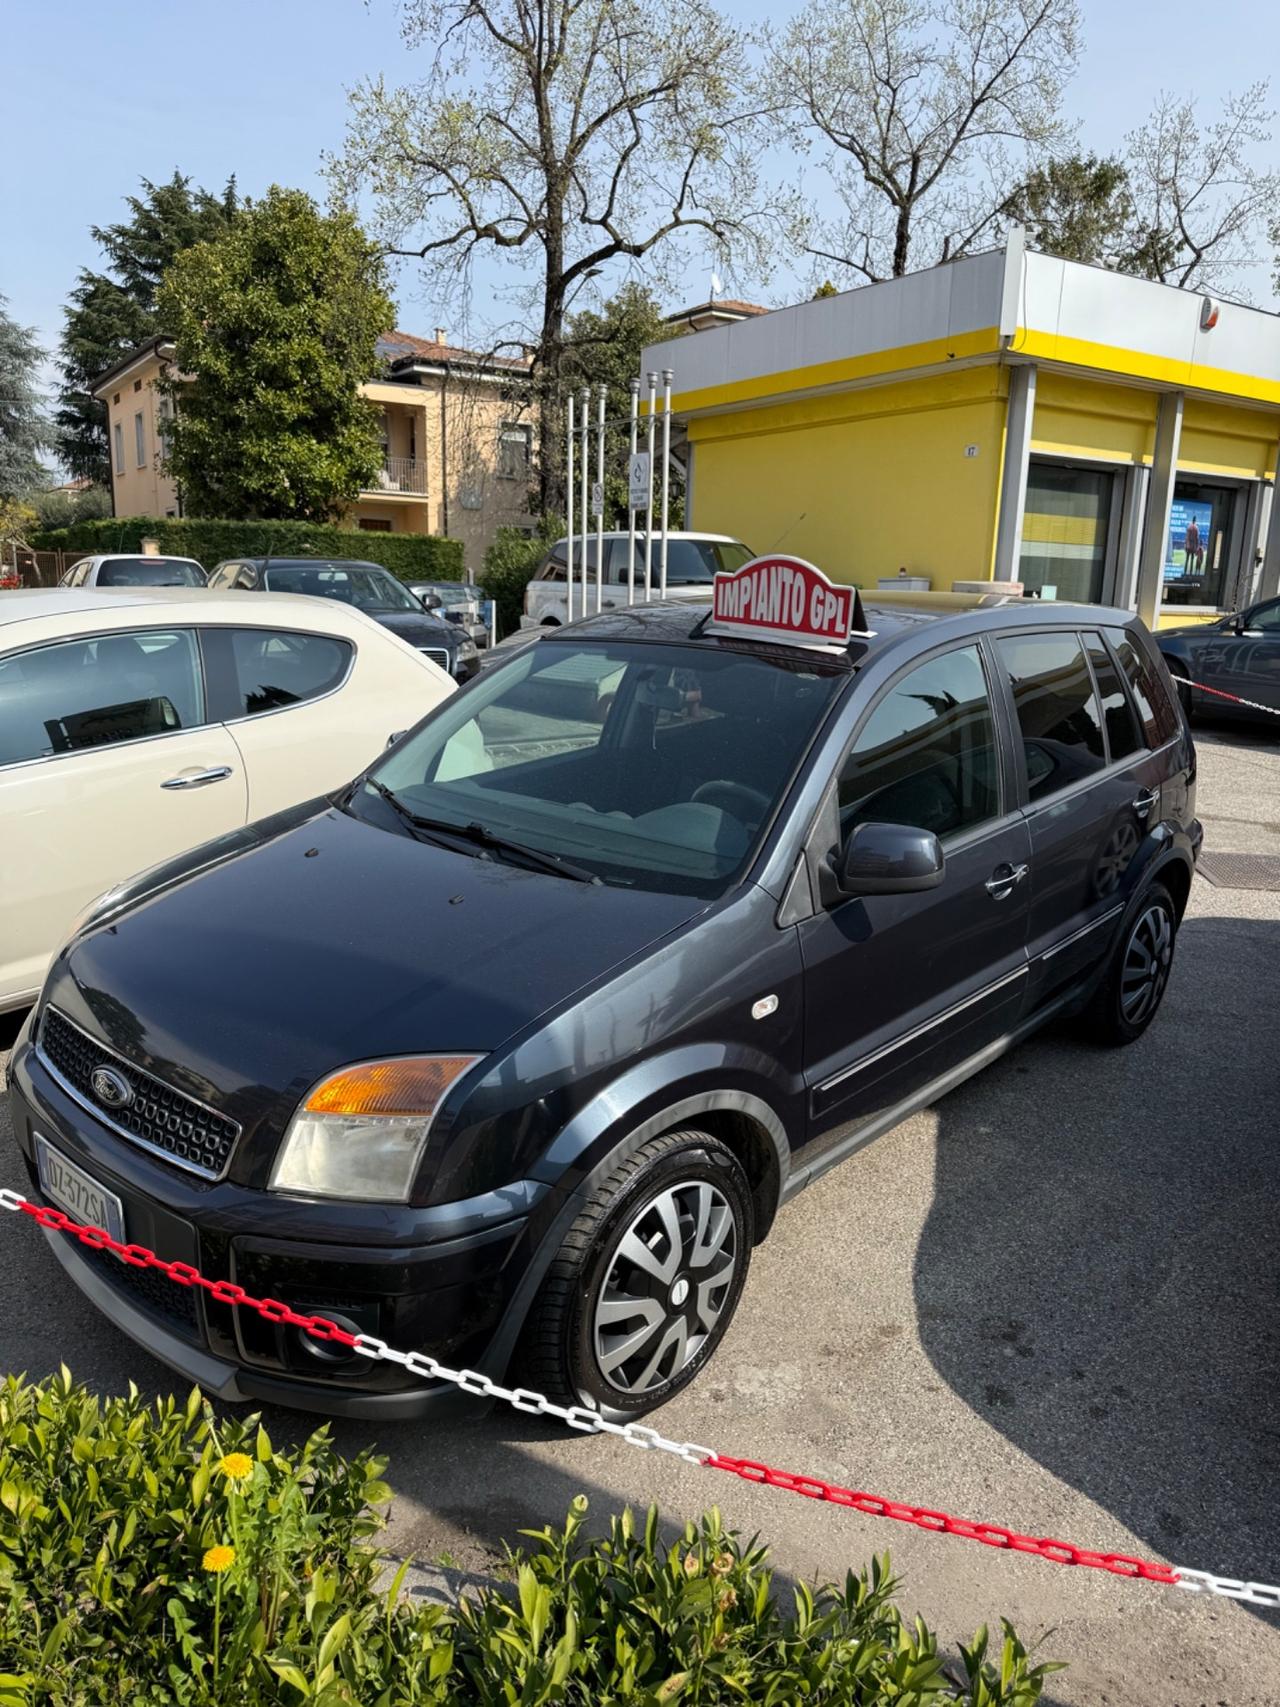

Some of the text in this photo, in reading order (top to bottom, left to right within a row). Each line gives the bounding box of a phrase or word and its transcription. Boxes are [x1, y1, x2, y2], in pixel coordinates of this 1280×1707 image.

[717, 566, 846, 633] IMPIANTO GPL
[95, 1074, 117, 1099] Ford
